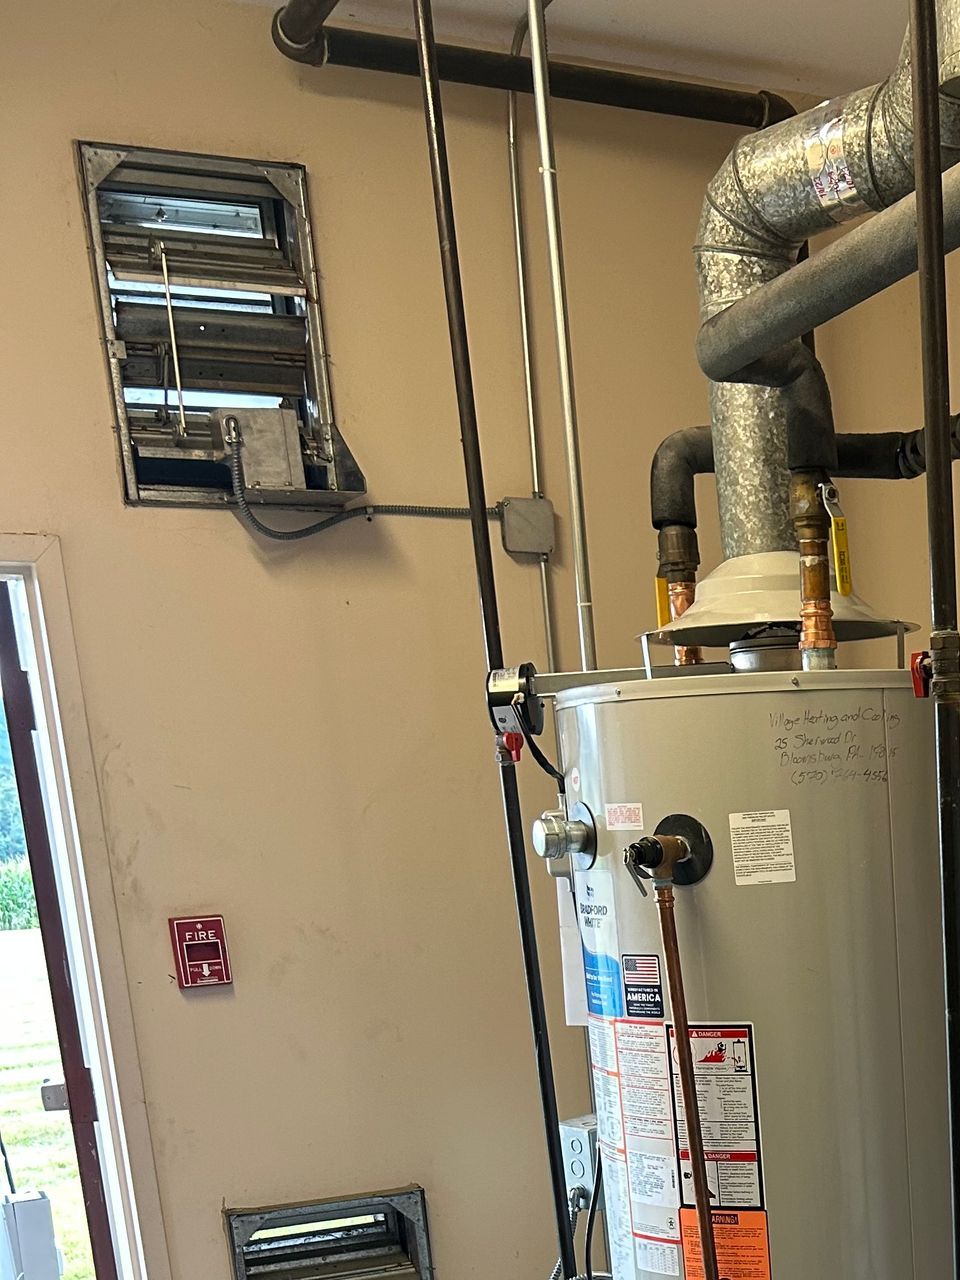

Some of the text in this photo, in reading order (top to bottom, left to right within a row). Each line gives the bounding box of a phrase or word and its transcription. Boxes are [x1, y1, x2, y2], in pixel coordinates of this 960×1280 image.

[769, 712, 800, 731] Village
[804, 709, 838, 730] Heating
[840, 706, 861, 722] and
[580, 902, 608, 916] BRADFORD
[186, 930, 216, 941] FIRE
[627, 993, 661, 1002] AMERICA
[712, 1215, 738, 1223] ARNING!
